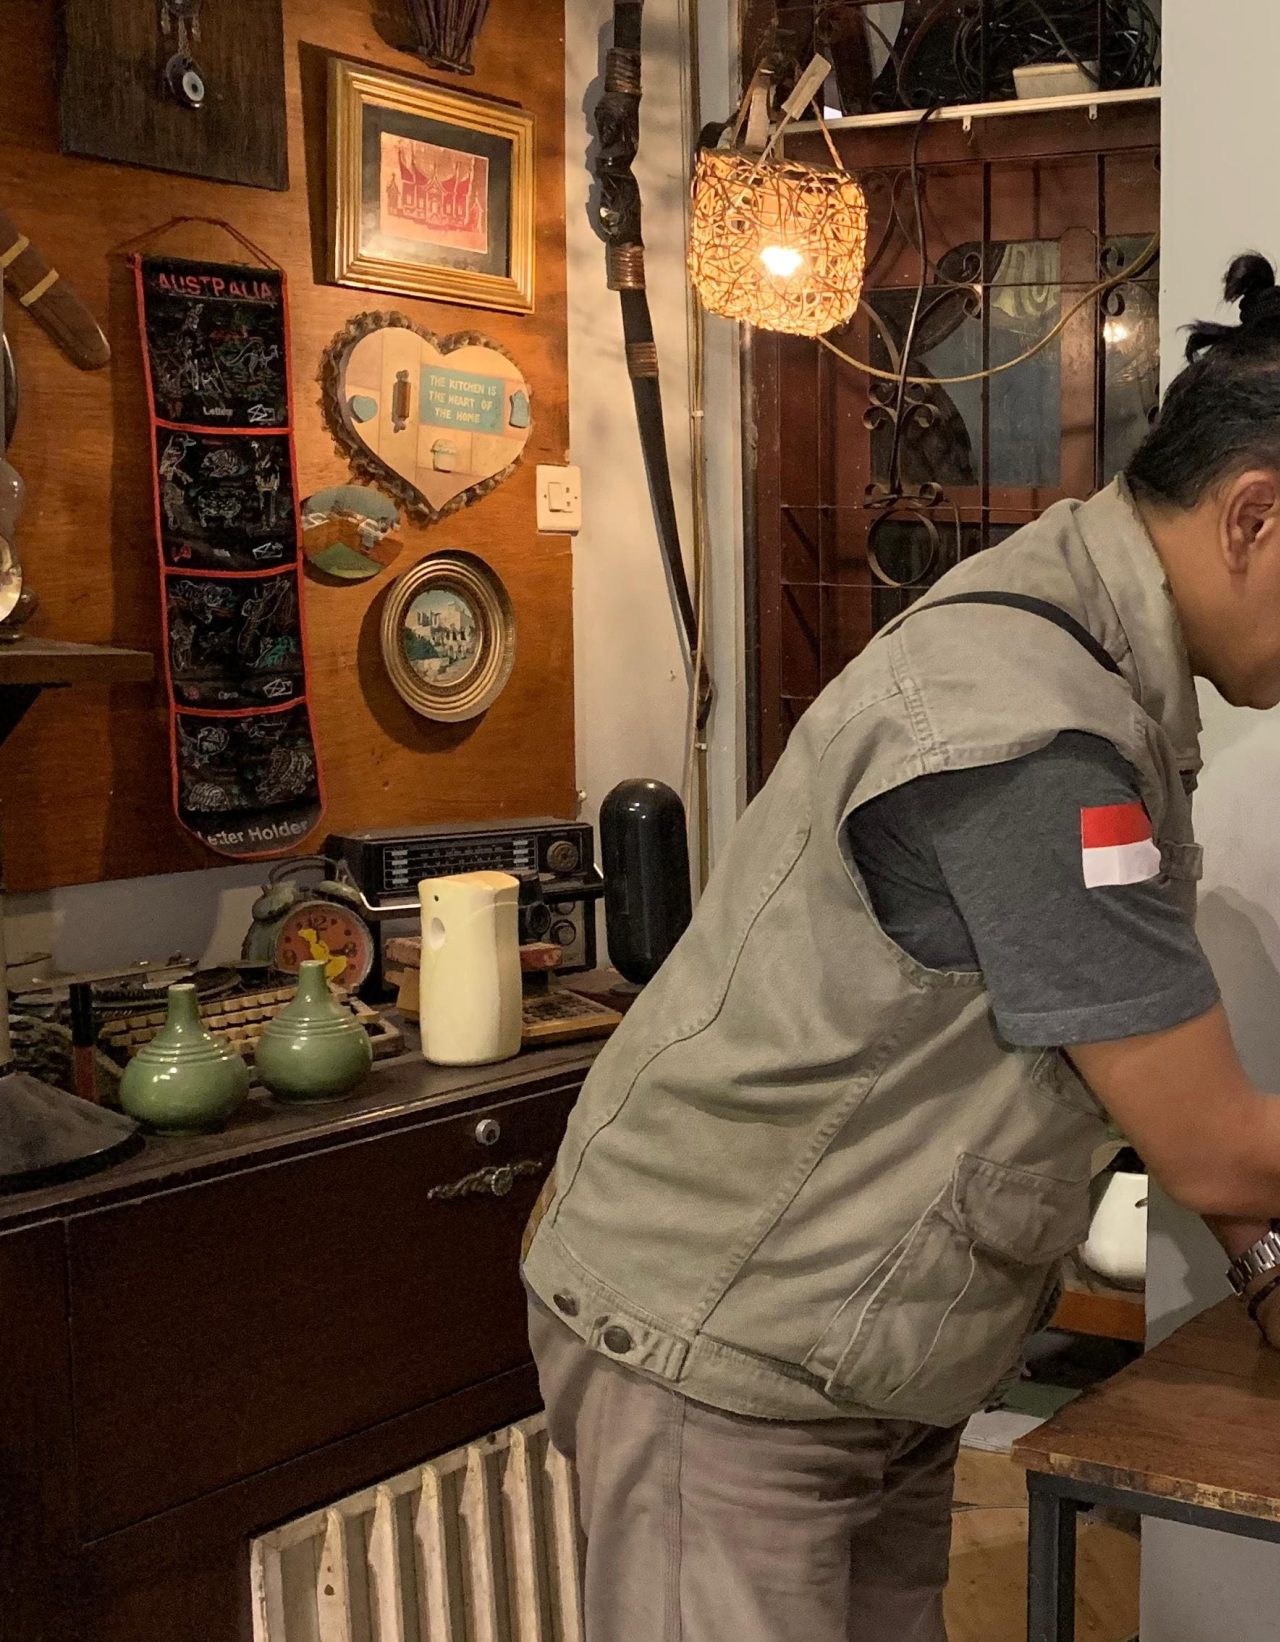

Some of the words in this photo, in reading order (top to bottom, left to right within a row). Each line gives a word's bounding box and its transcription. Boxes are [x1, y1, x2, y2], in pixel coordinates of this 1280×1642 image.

[430, 375, 446, 387] THE
[449, 379, 484, 394] KITCHEN
[488, 386, 497, 397] IS
[428, 390, 445, 403] THE
[448, 394, 475, 408] HEART
[481, 400, 493, 411] OF
[434, 407, 451, 419] THE
[456, 411, 480, 423] HOME
[247, 821, 308, 841] Holder
